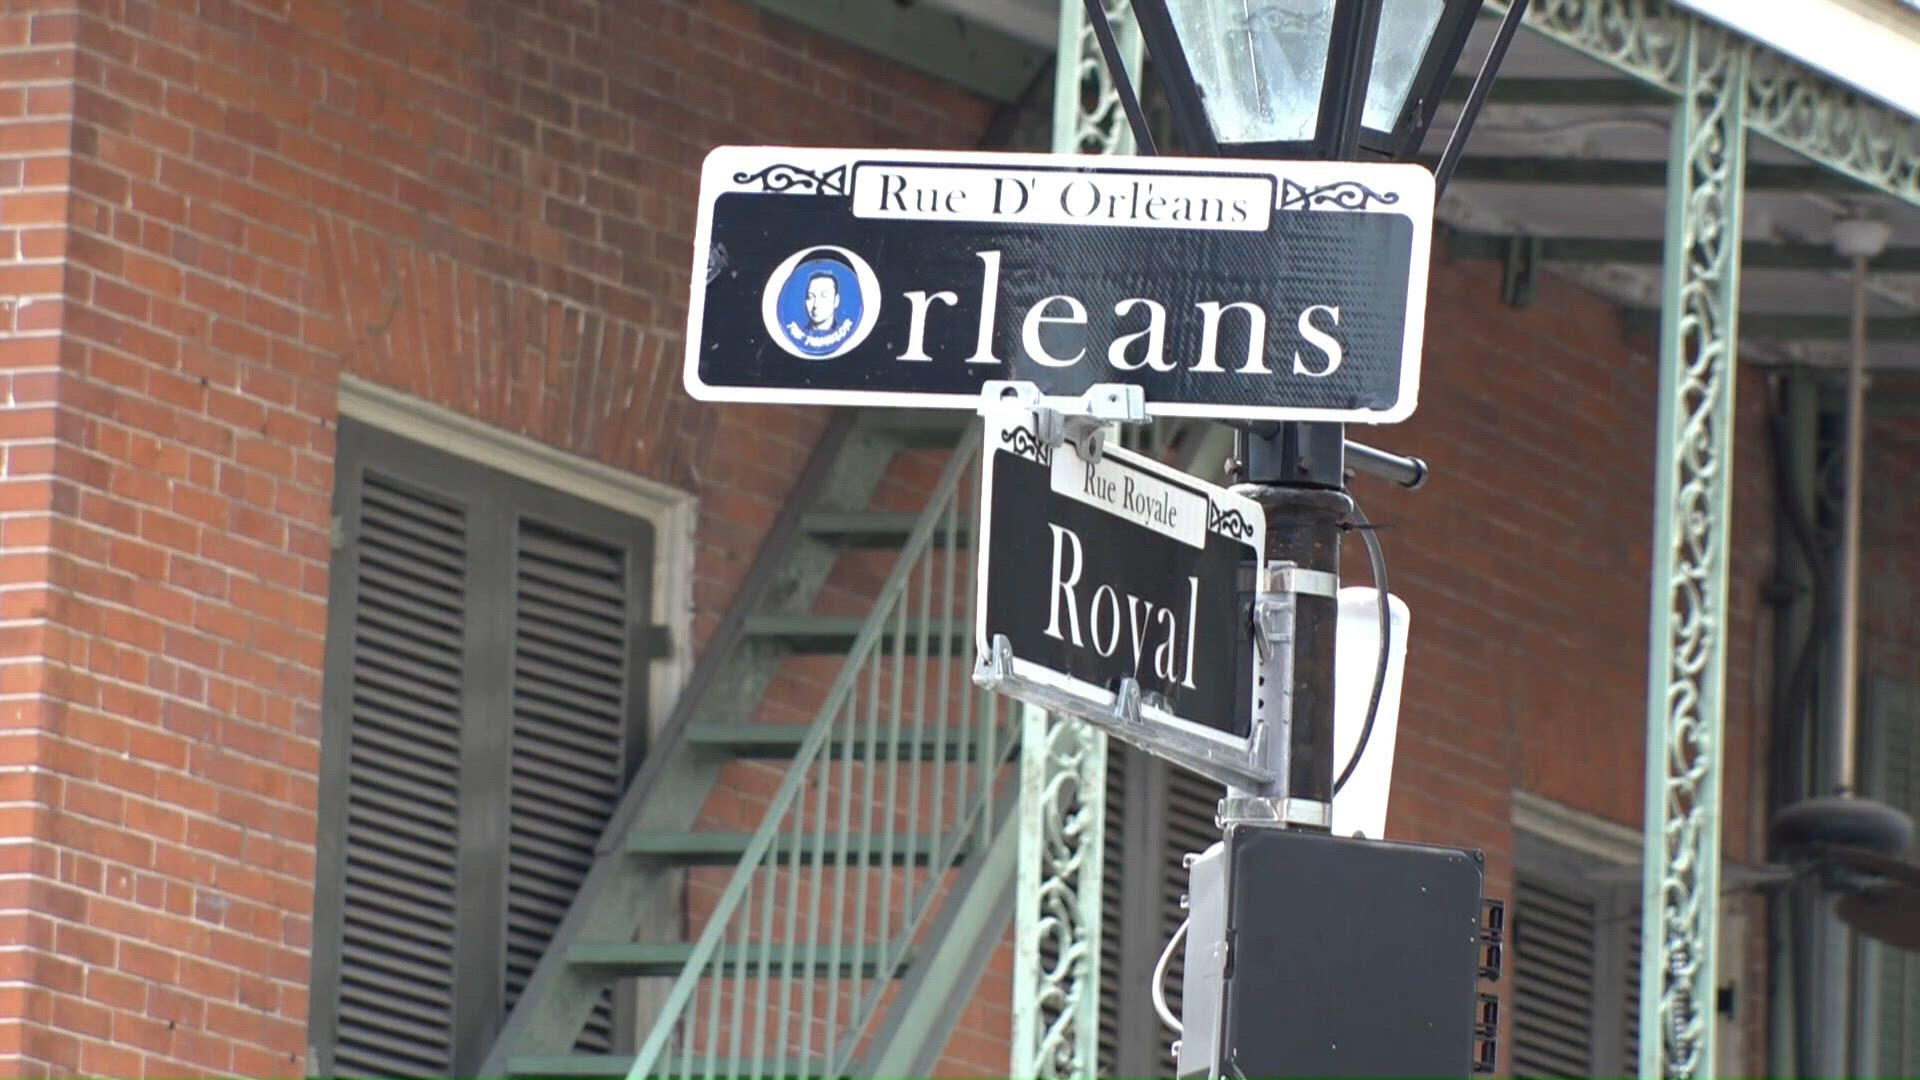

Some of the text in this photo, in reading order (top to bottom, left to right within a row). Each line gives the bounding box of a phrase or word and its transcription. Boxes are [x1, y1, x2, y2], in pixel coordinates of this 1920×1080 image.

[878, 173, 967, 212] Rue
[992, 177, 1036, 215] D'
[760, 244, 1345, 379] Orleans
[1083, 461, 1178, 528] Rue Royale
[1043, 522, 1198, 690] Royal
